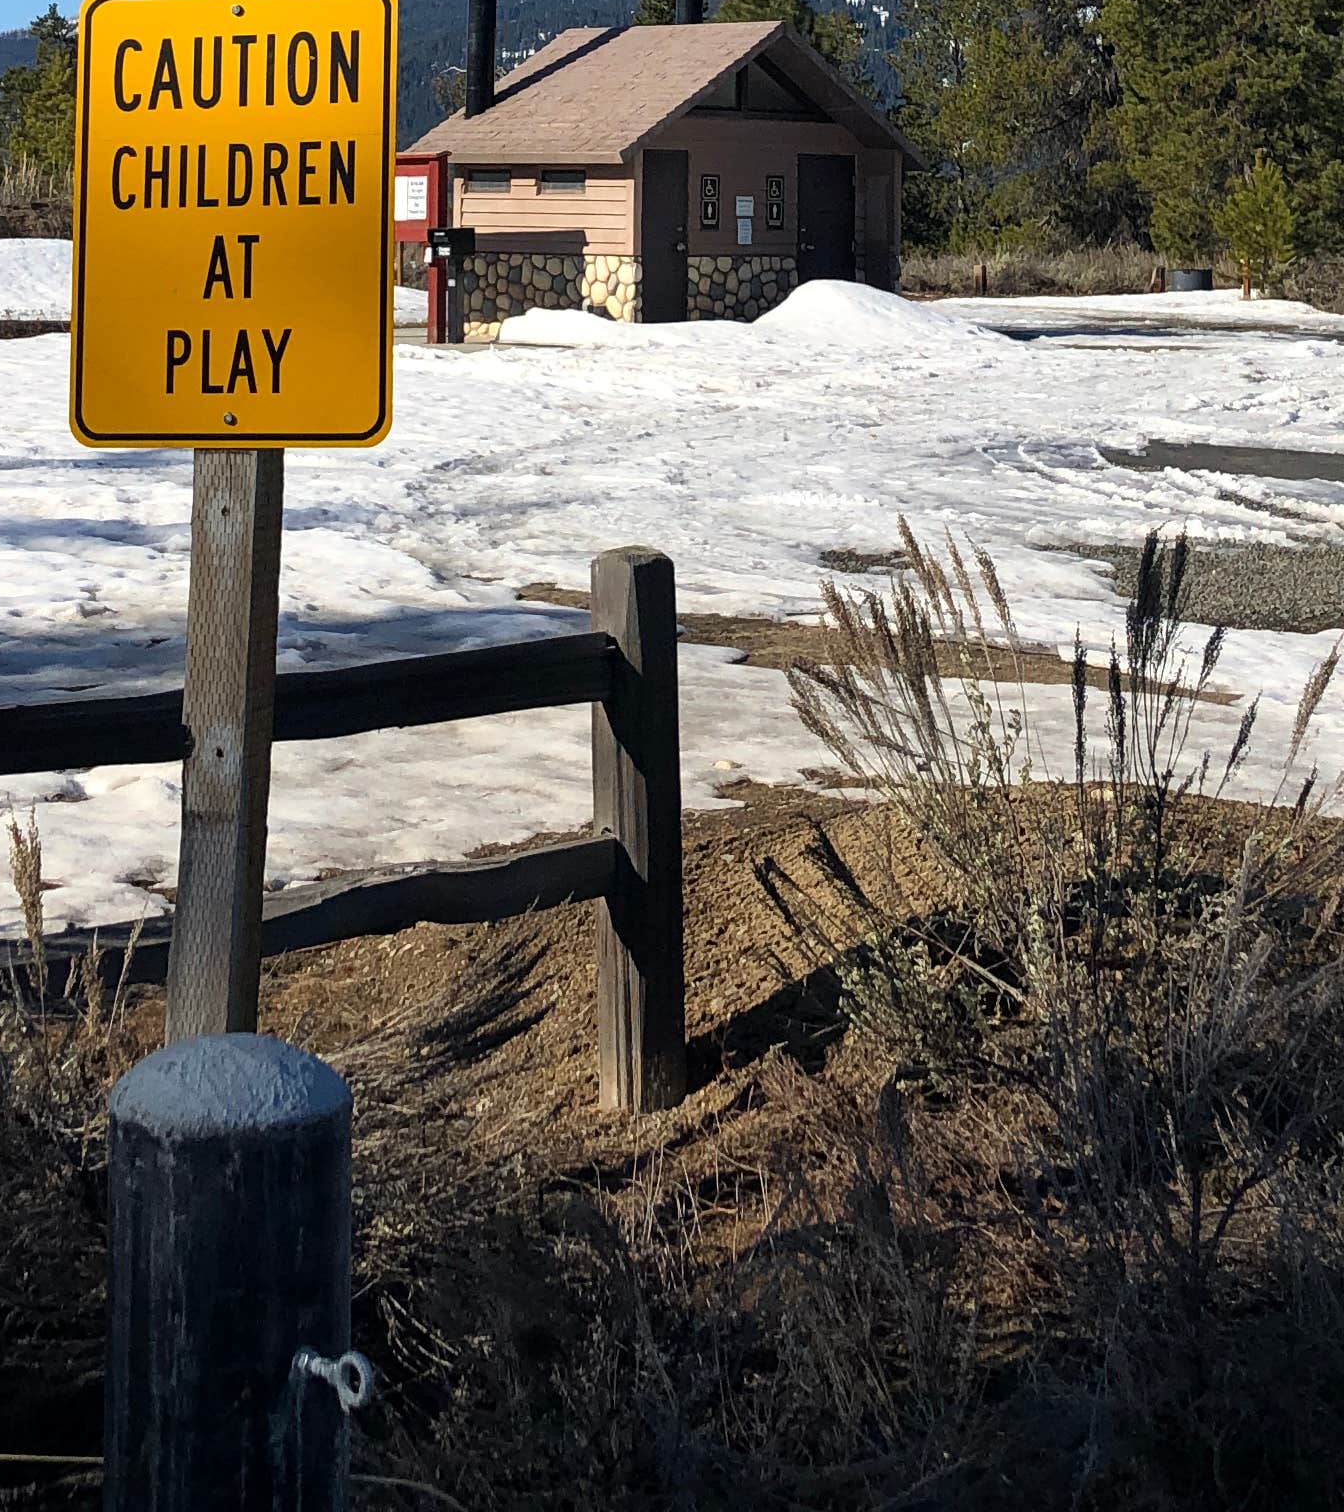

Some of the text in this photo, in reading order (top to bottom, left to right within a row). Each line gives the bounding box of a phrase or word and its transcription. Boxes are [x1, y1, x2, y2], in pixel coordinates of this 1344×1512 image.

[113, 29, 360, 113] CAUTION
[111, 140, 356, 211] CHILDREN
[202, 234, 260, 300] AT
[165, 328, 292, 395] PLAY
